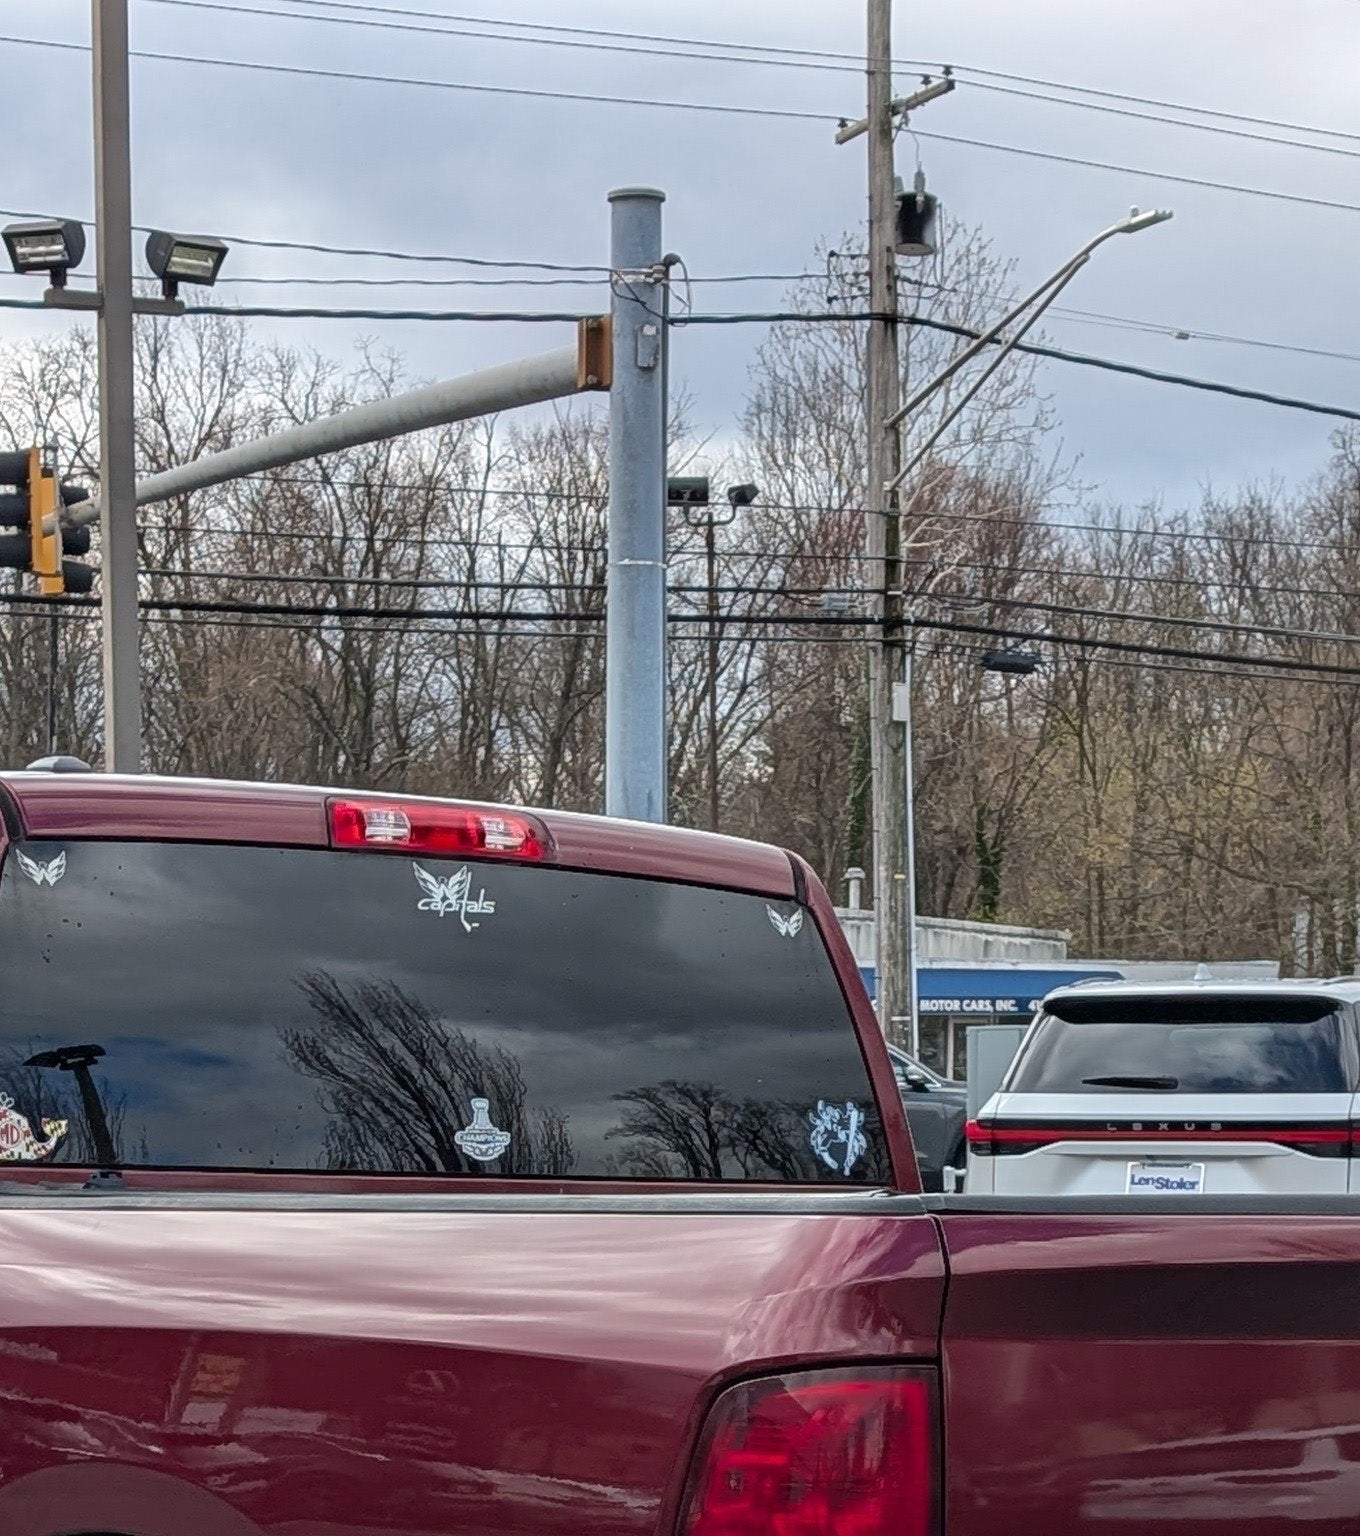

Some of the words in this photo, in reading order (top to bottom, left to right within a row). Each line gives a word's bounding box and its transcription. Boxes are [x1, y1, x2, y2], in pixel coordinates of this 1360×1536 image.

[919, 999, 961, 1012] MOTOR
[996, 999, 1019, 1012] INC.
[1107, 1122, 1222, 1131] LEXUS
